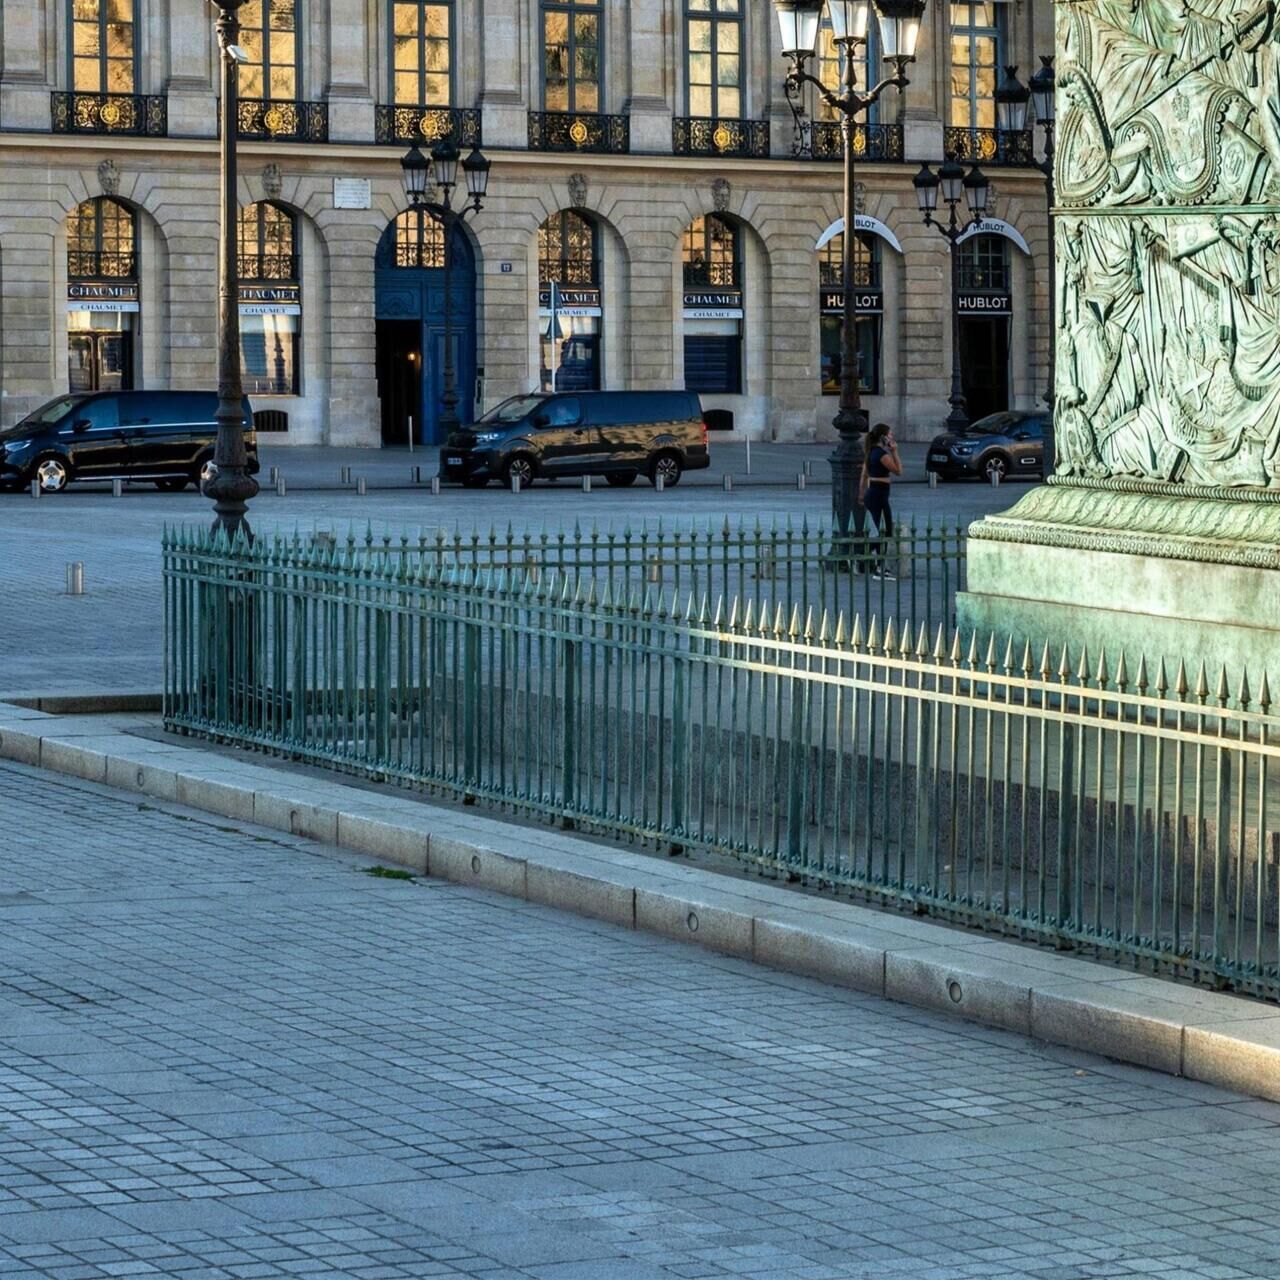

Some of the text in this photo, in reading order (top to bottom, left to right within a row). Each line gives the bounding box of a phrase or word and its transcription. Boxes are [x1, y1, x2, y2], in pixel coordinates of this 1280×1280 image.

[843, 219, 876, 229] BLOT
[69, 287, 136, 296] CHAUMET
[239, 289, 298, 299] HAUMET
[540, 293, 599, 302] CAUMET
[684, 295, 740, 304] CHAUMET
[827, 295, 878, 307] HULOT
[958, 297, 1008, 309] HUBLOT
